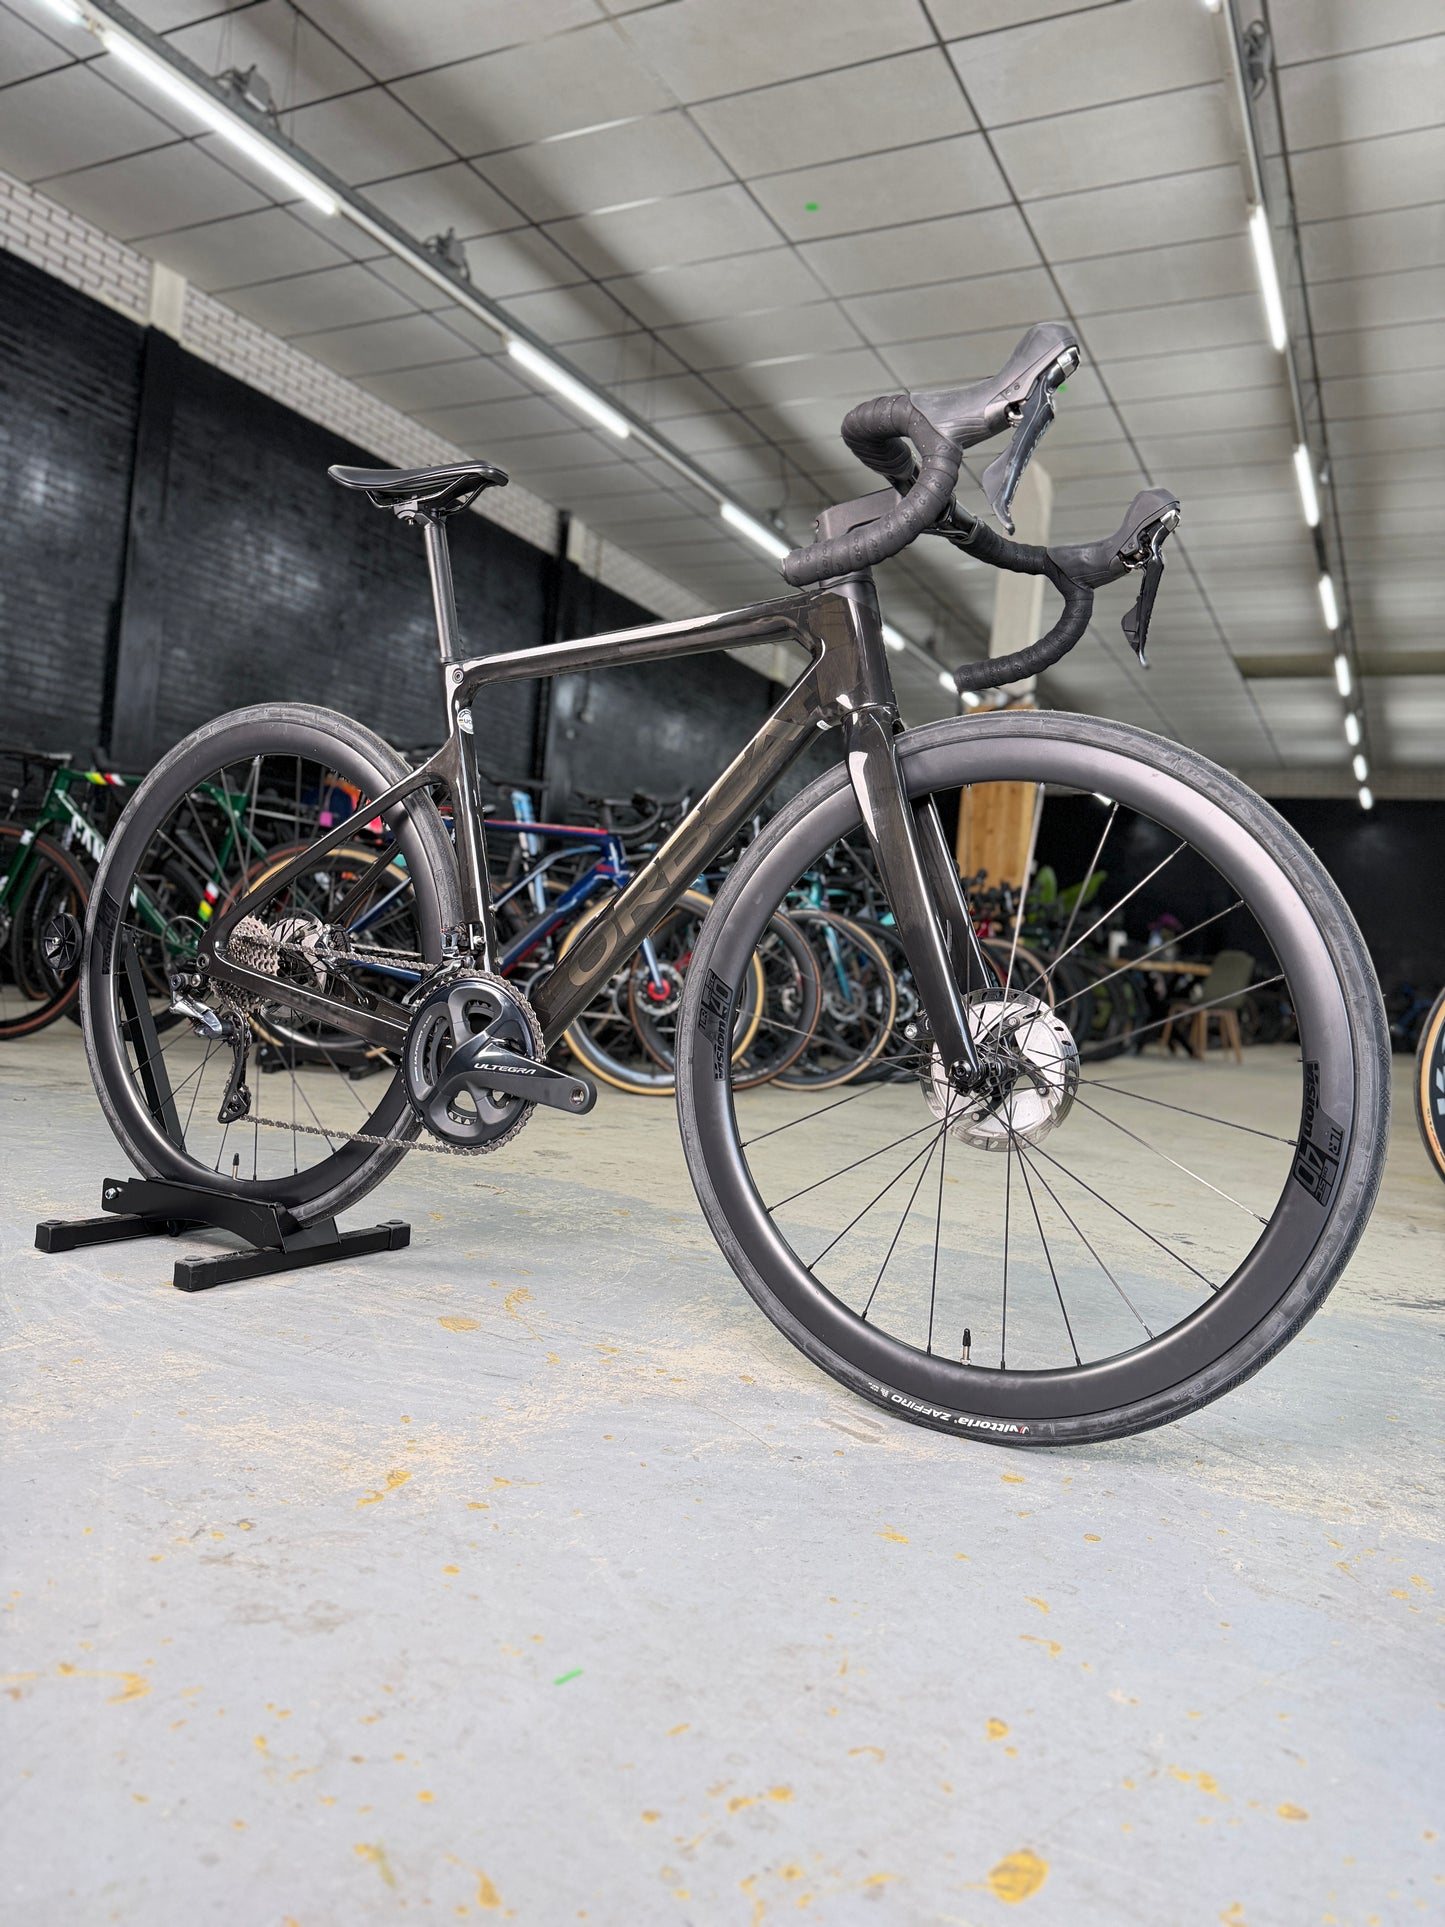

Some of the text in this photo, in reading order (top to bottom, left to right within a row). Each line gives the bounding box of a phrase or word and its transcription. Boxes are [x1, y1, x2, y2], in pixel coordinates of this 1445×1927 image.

[711, 977, 732, 1016] 40
[474, 1062, 537, 1075] ULTEGRA
[1303, 1062, 1320, 1139] Vision
[1328, 1127, 1343, 1156] TLR
[1295, 1144, 1323, 1192] 40
[891, 1394, 952, 1422] ZAFFIRO
